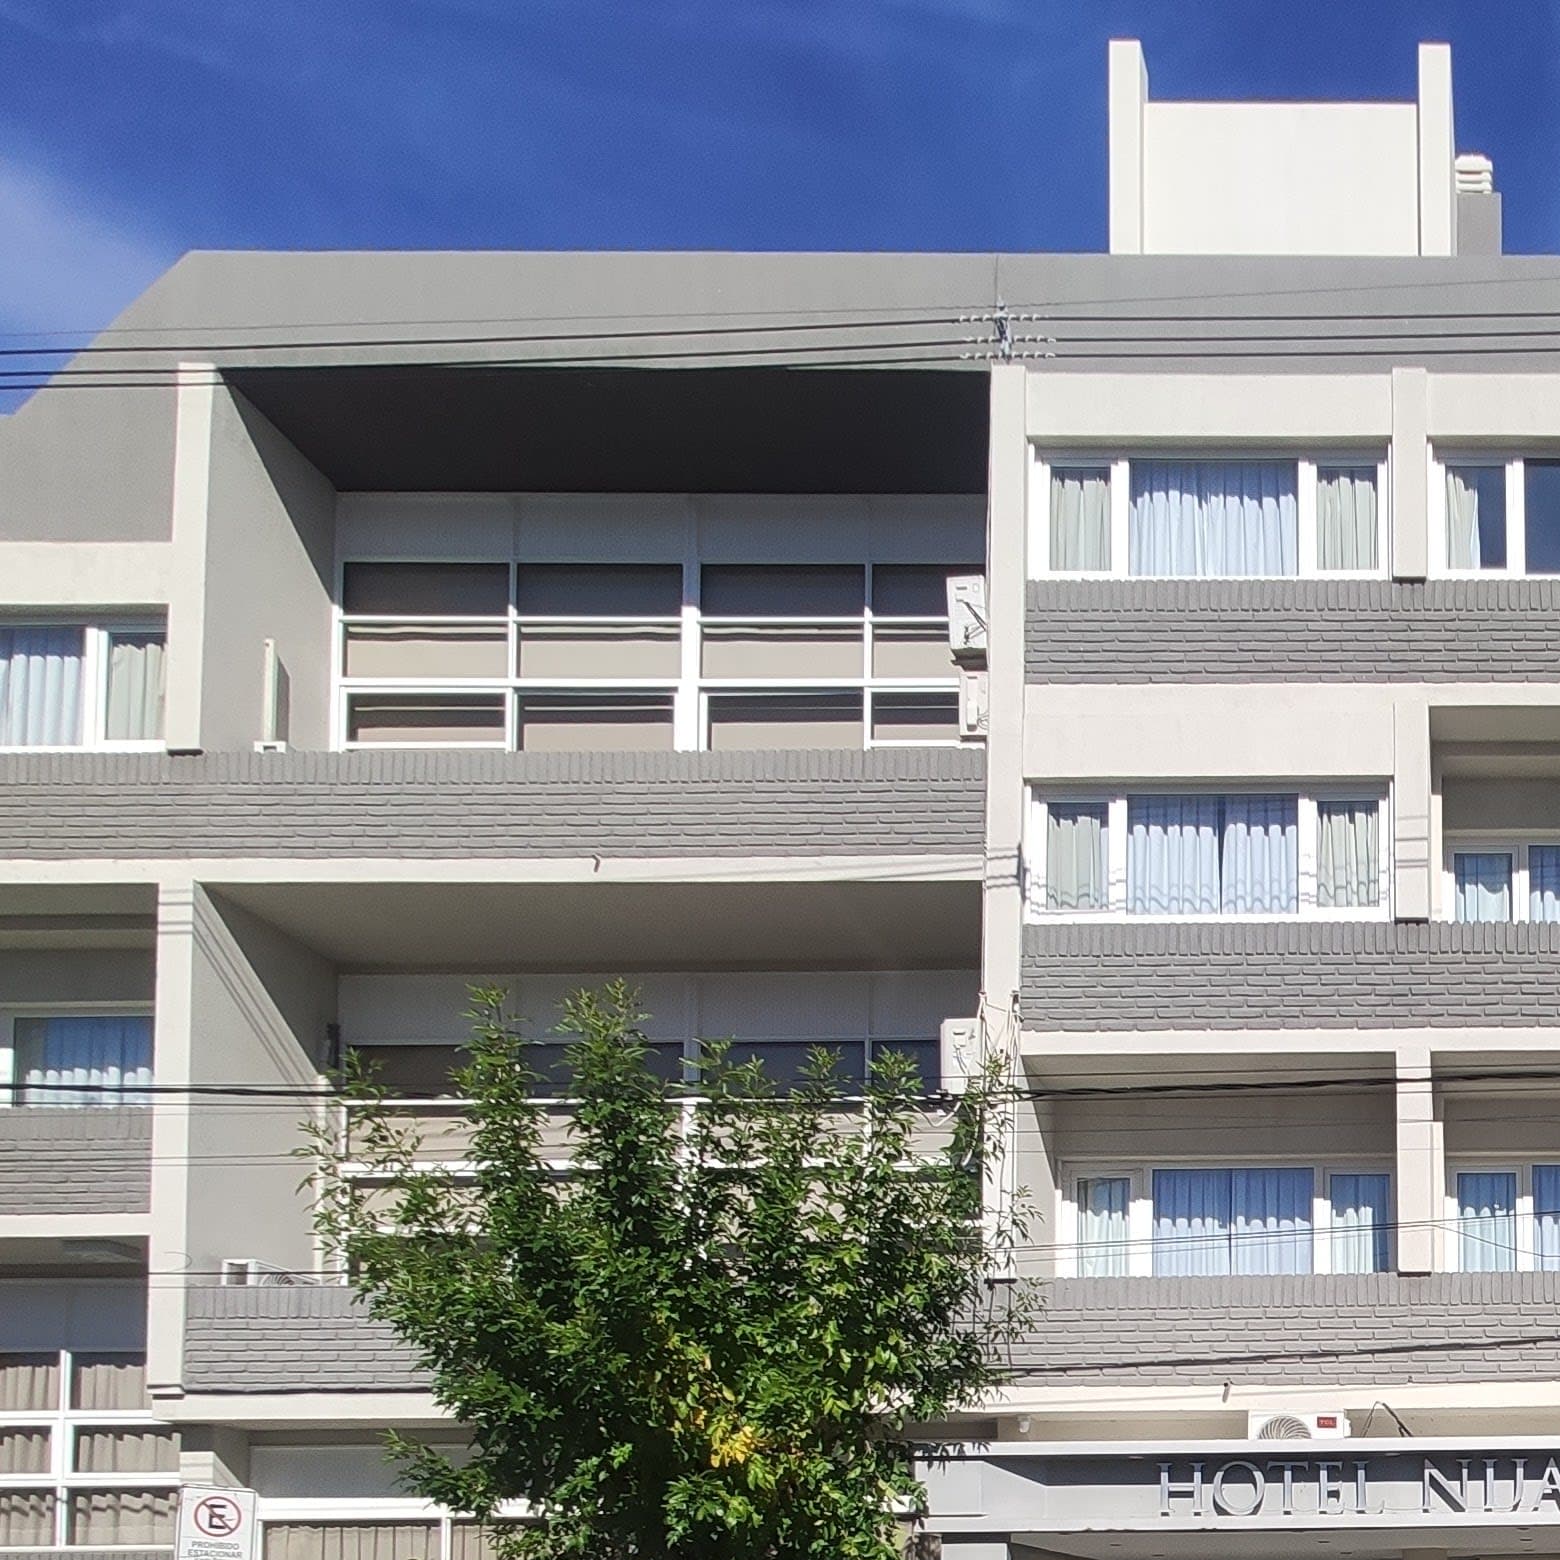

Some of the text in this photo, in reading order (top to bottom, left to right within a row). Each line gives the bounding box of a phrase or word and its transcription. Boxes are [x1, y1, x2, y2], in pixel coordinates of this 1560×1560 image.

[1156, 1460, 1384, 1515] HOTEL
[191, 1541, 240, 1550] PROHIBIDO
[187, 1549, 242, 1558] ESTACIONAR
